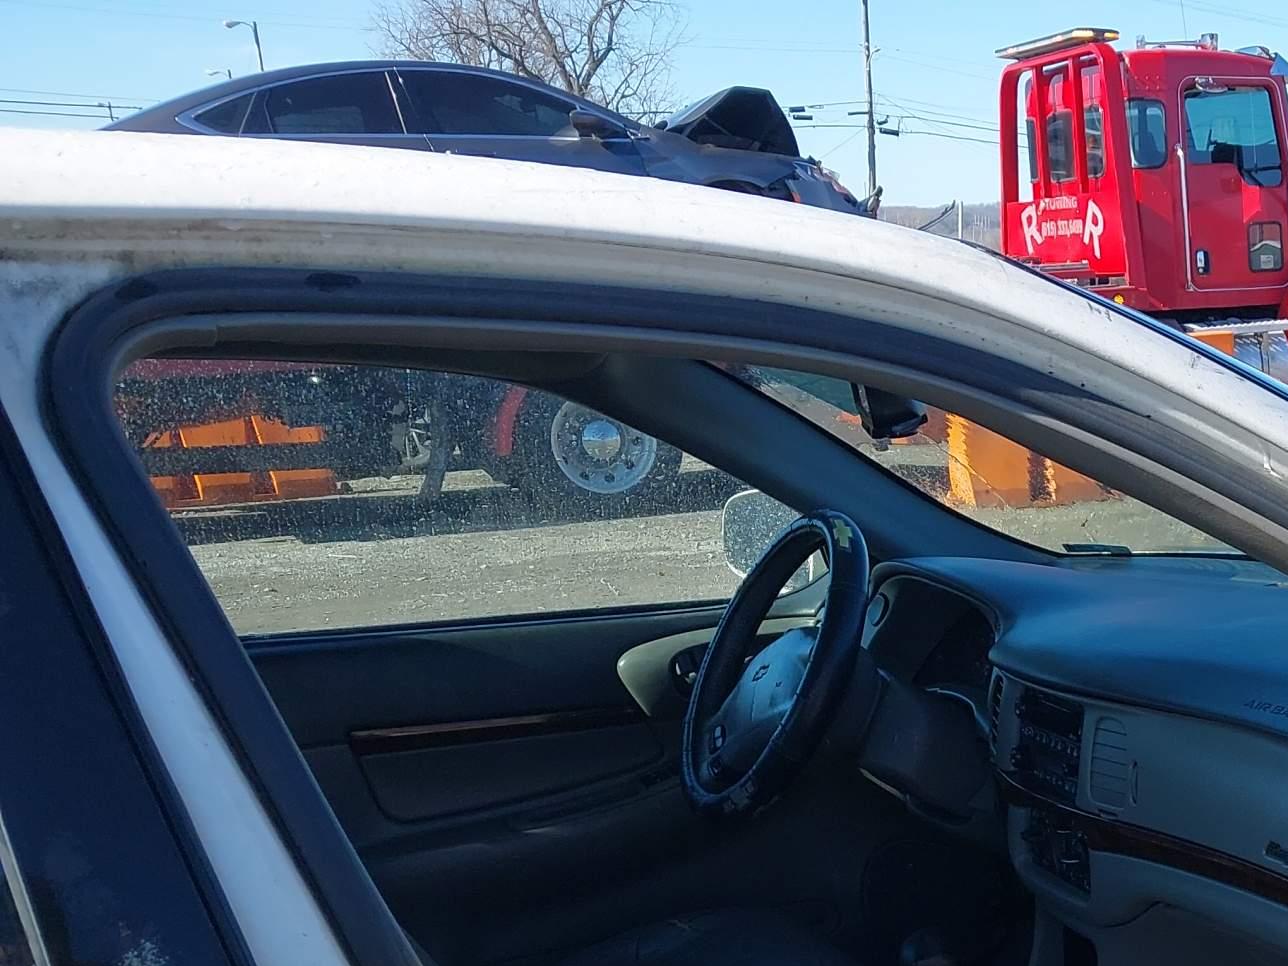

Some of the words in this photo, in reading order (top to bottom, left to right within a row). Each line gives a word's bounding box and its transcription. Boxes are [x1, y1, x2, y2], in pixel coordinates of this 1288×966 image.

[1045, 196, 1078, 210] TOWING
[1021, 203, 1044, 256] R
[1083, 198, 1104, 260] R
[1243, 699, 1272, 713] AIR
